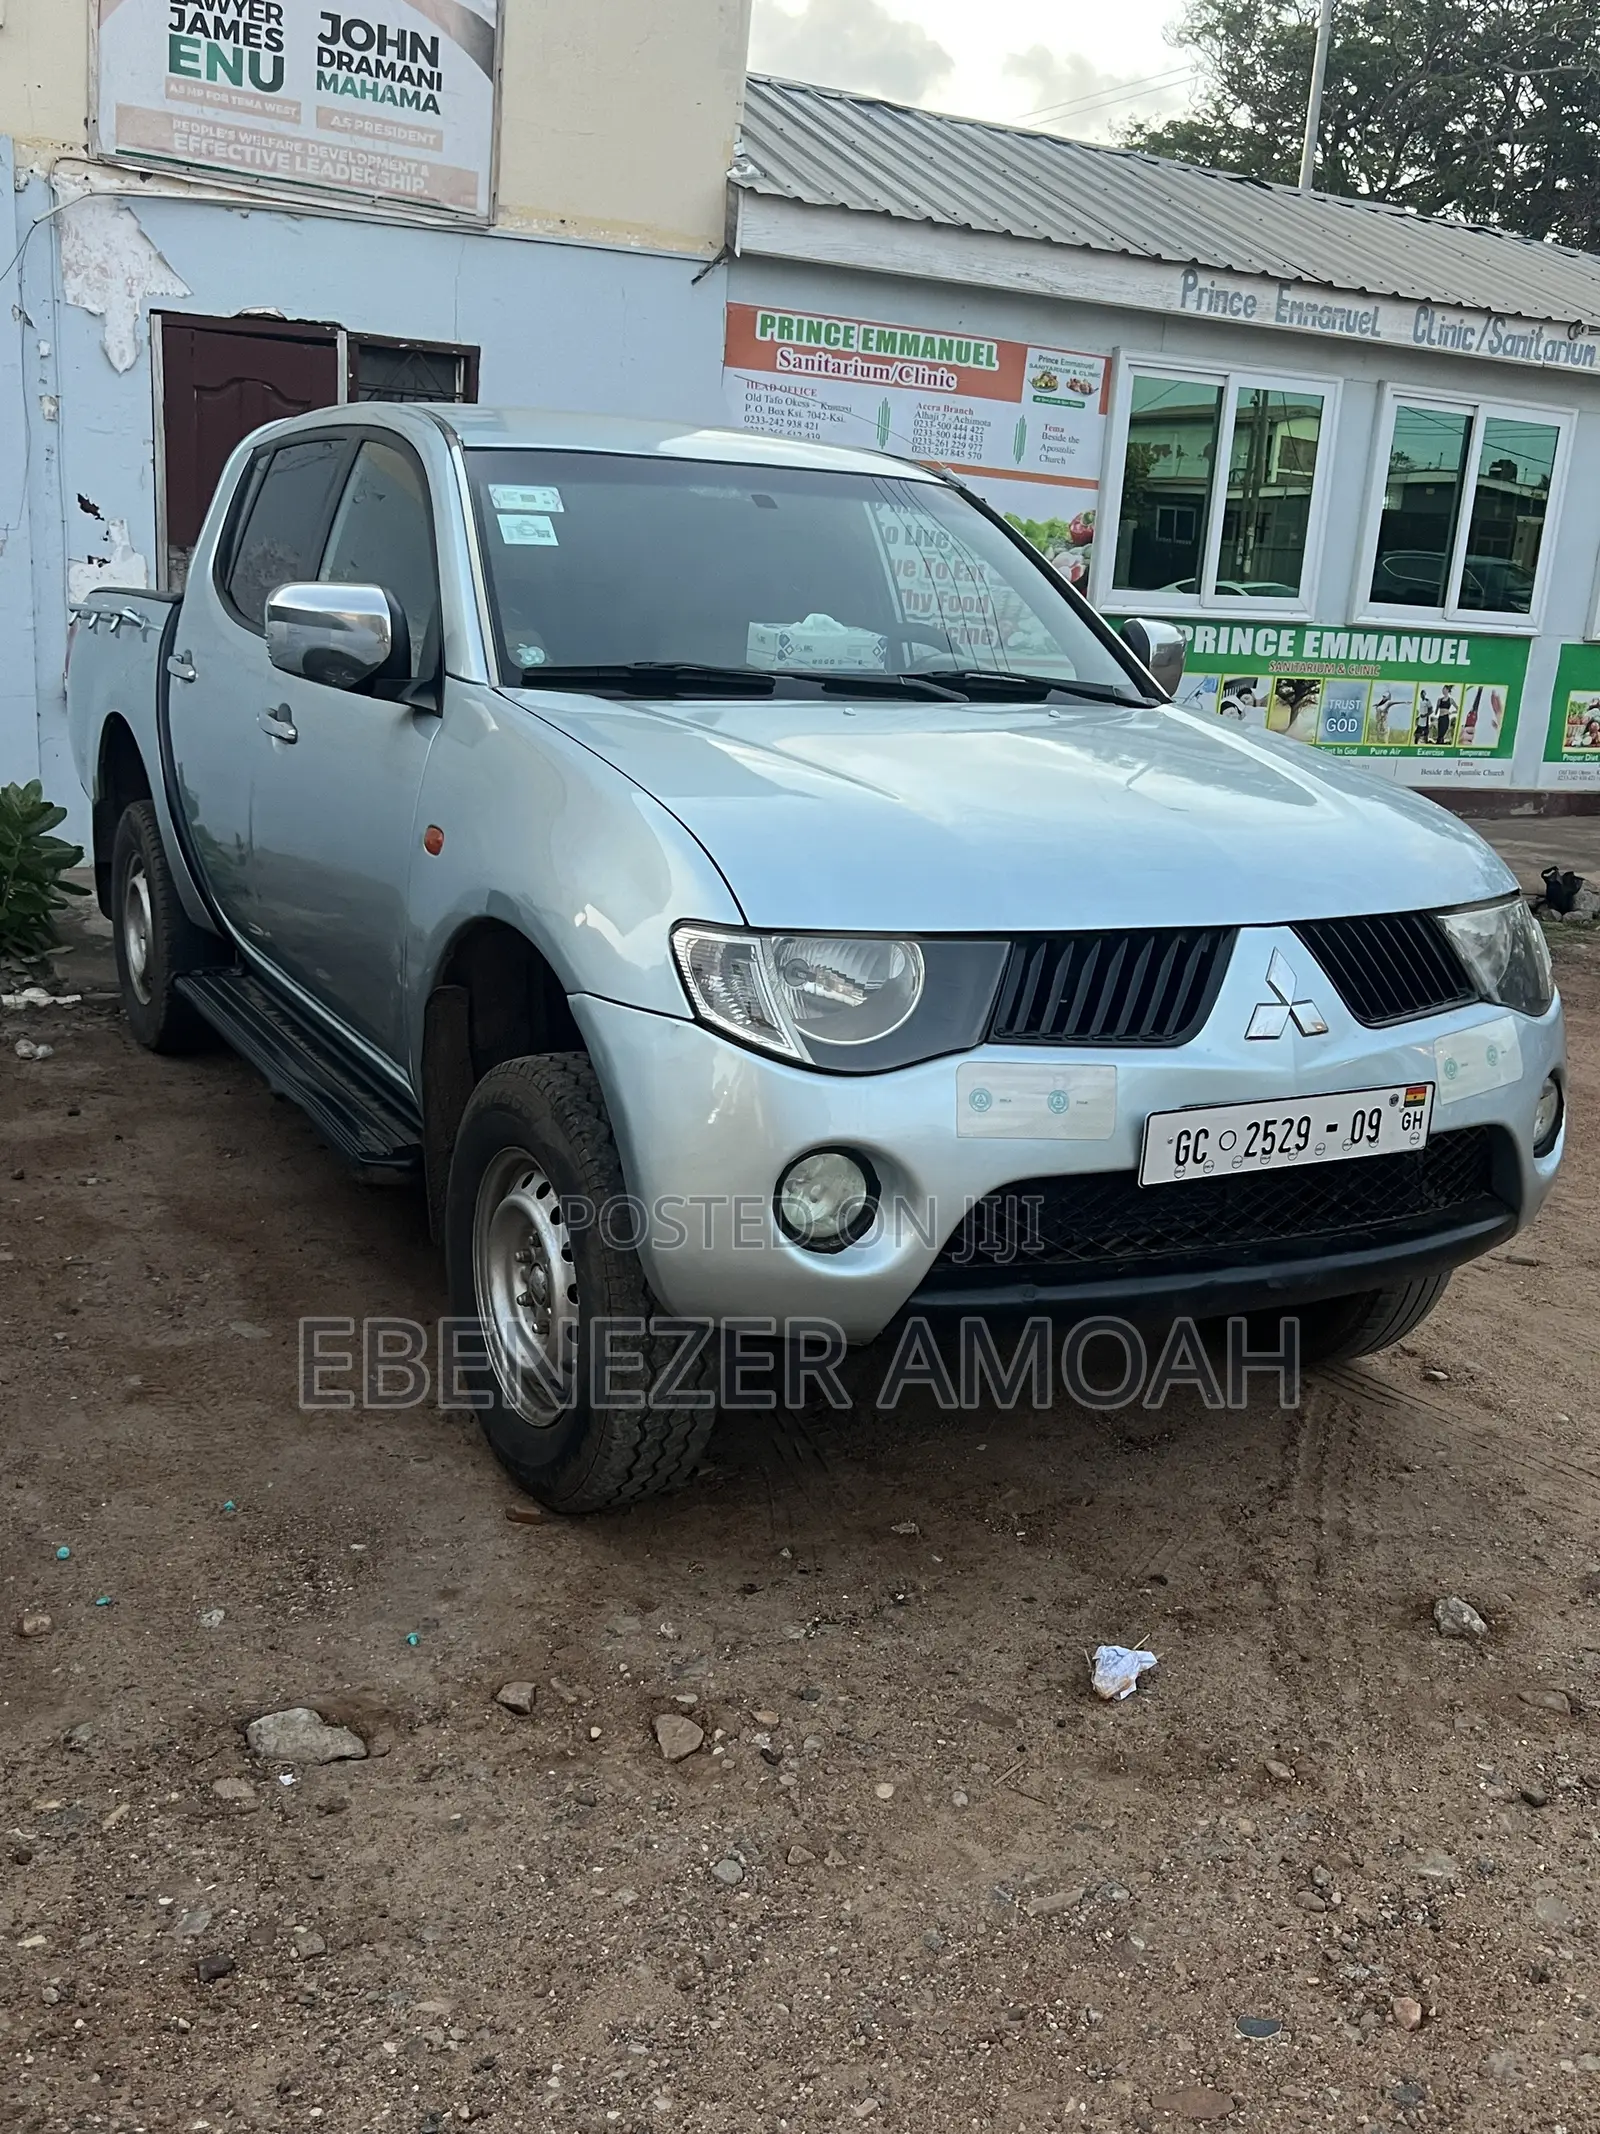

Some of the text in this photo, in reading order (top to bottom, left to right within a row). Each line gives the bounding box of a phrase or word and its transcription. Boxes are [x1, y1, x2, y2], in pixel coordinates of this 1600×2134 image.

[168, 6, 284, 53] JAMES
[317, 10, 440, 69] JOHN
[168, 33, 285, 93] ENU
[316, 45, 443, 92] DRAMANI
[316, 69, 442, 116] MAHAMA
[330, 115, 437, 145] AS PRESIDENT
[173, 132, 290, 171] EFFECTIVE
[308, 143, 418, 174] DEVELOPMENT
[1180, 268, 1258, 318] Prince
[759, 313, 998, 368] PRINCE EMMANUEL
[778, 349, 956, 389] Sanitarium/Clinic
[1038, 355, 1095, 370] Prince Emmanuel
[745, 392, 762, 403] Old
[768, 406, 785, 417] Box
[916, 402, 974, 416] Accra Branch
[744, 415, 784, 427] 0233-242
[953, 415, 992, 427] Achimota
[1044, 423, 1065, 433] Tema
[1042, 432, 1080, 444] Beside the
[1039, 454, 1066, 465] Church
[1302, 630, 1470, 665] EMMANUEL
[1268, 660, 1381, 676] SANITARIUM & CLINIC
[1329, 699, 1361, 710] TRUST
[1326, 718, 1358, 732] GOD
[1344, 747, 1358, 755] God
[1370, 747, 1388, 755] Pure
[1417, 748, 1445, 756] Exercise
[1401, 1110, 1423, 1131] GH
[1175, 1128, 1210, 1166] GC
[1244, 1115, 1311, 1158] 2529
[1350, 1107, 1382, 1144] 09
